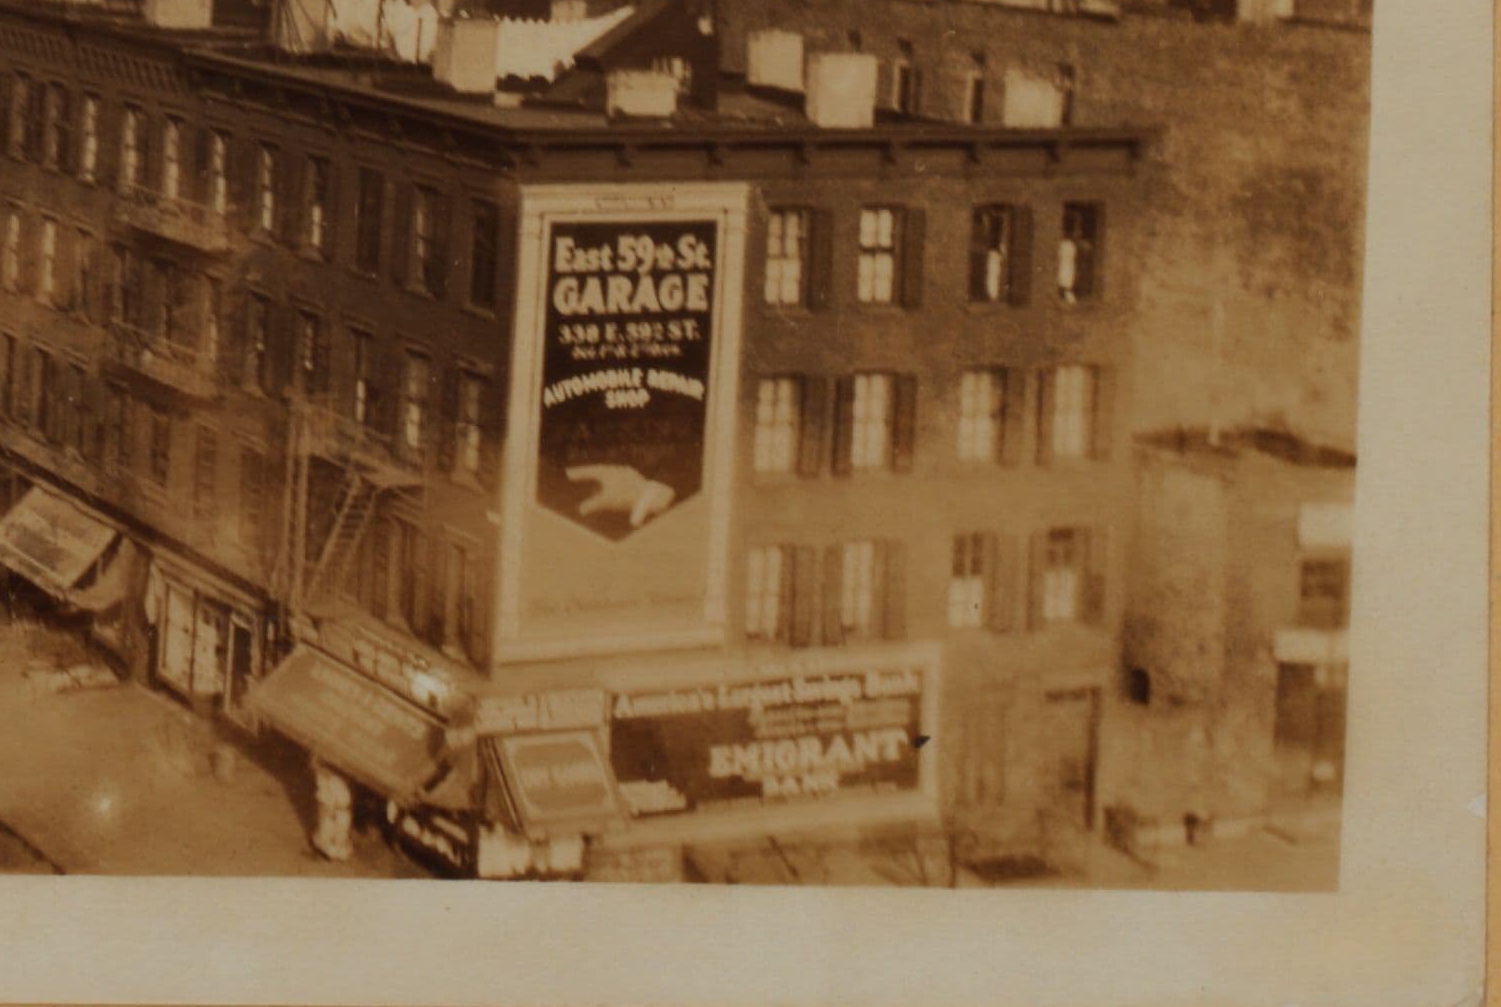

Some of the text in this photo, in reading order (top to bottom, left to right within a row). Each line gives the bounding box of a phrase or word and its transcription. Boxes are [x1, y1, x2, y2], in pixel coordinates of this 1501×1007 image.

[555, 236, 614, 273] East
[553, 273, 709, 315] GARAGE
[708, 727, 909, 781] EMIGRANT
